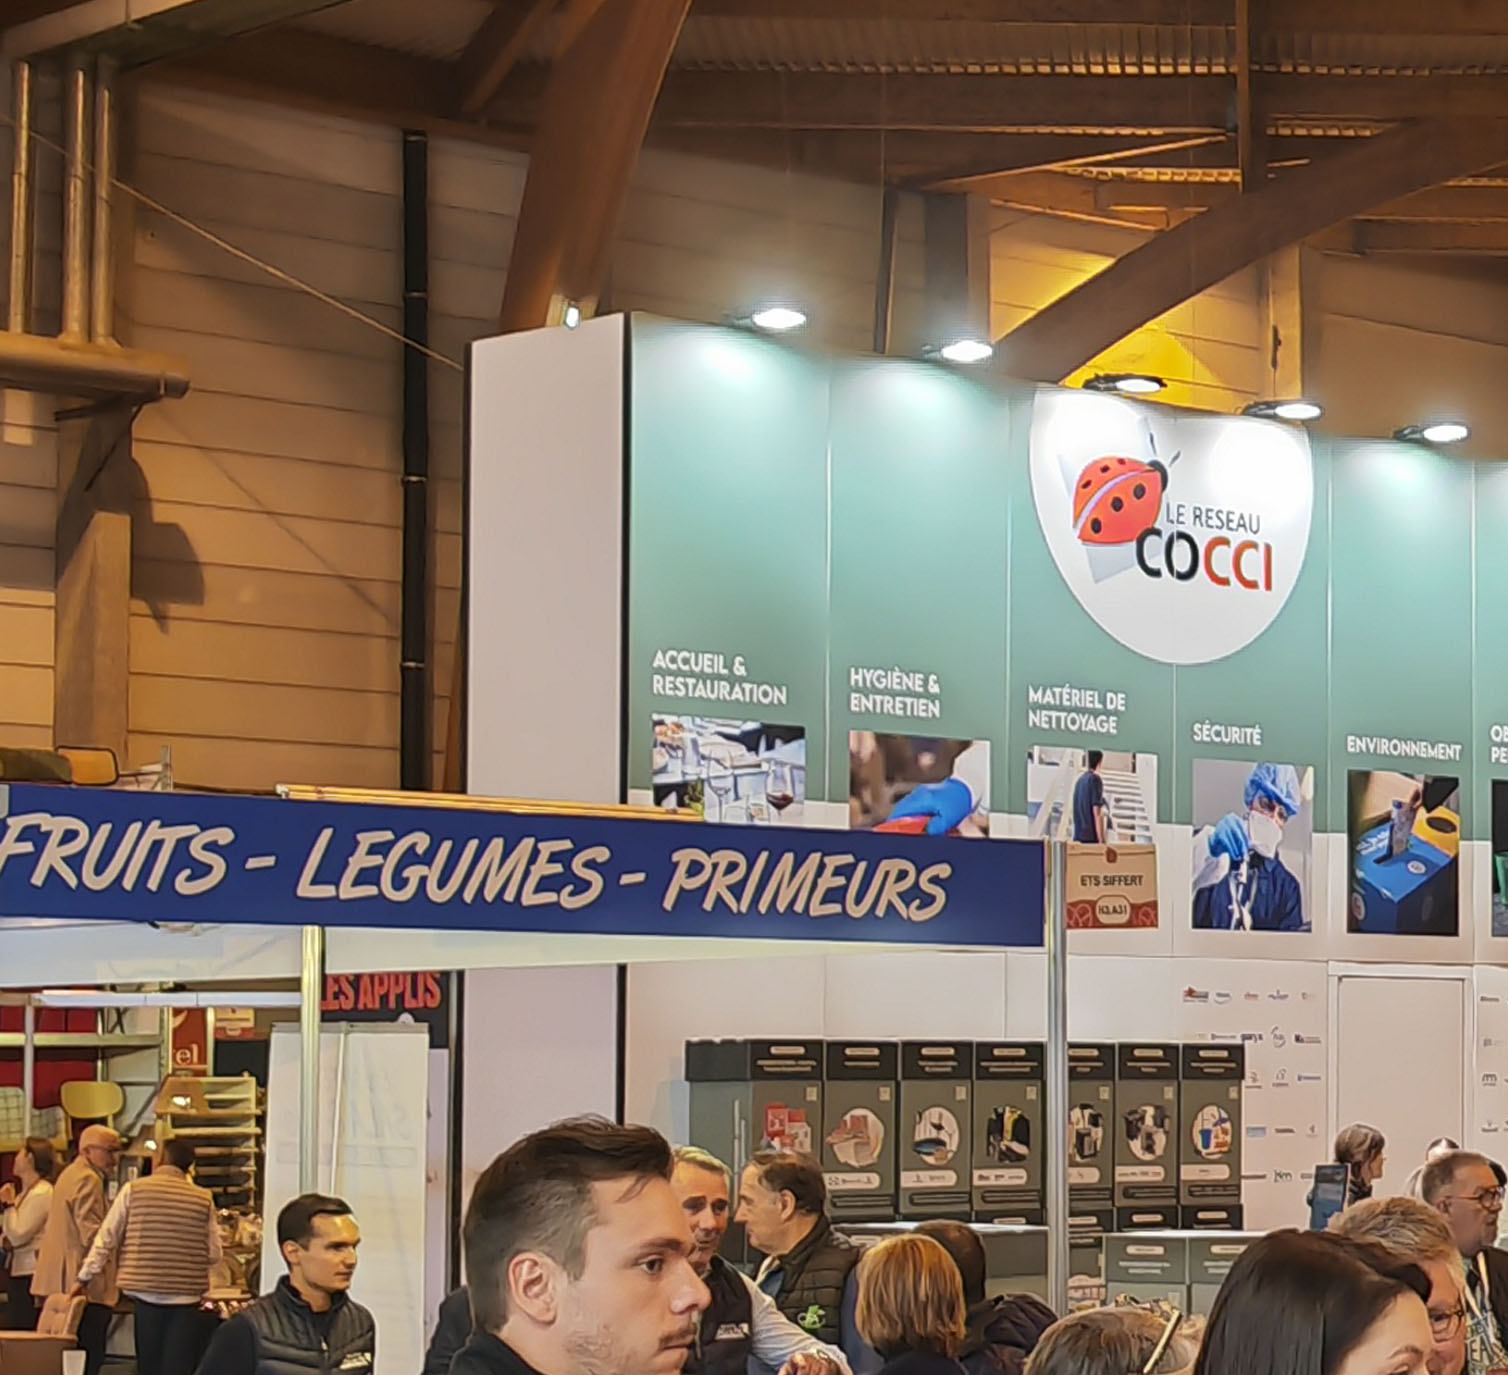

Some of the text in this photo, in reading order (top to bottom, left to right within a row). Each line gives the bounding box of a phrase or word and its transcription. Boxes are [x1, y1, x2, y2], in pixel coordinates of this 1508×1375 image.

[1165, 502, 1261, 535] LE RESEAU
[1135, 527, 1273, 591] COCCI
[653, 650, 747, 676] ACCUEIL &
[653, 675, 787, 705] RESTAURATION
[850, 666, 940, 694] HYGIÈNE &
[850, 692, 940, 718] ENTRETIEN
[1028, 683, 1126, 711] MATÉRIEL DE
[1028, 709, 1117, 734] NETTOYAGE
[1193, 720, 1262, 745] SÉCURITÉ
[1347, 735, 1462, 761] ENVIRONNEMENT
[0, 812, 233, 894] FRUITS
[297, 828, 609, 909] LEGUMES
[662, 847, 952, 922] PRIMEURS
[1080, 875, 1144, 887] ETS SIFFERT
[319, 971, 441, 1011] ES APPLIS
